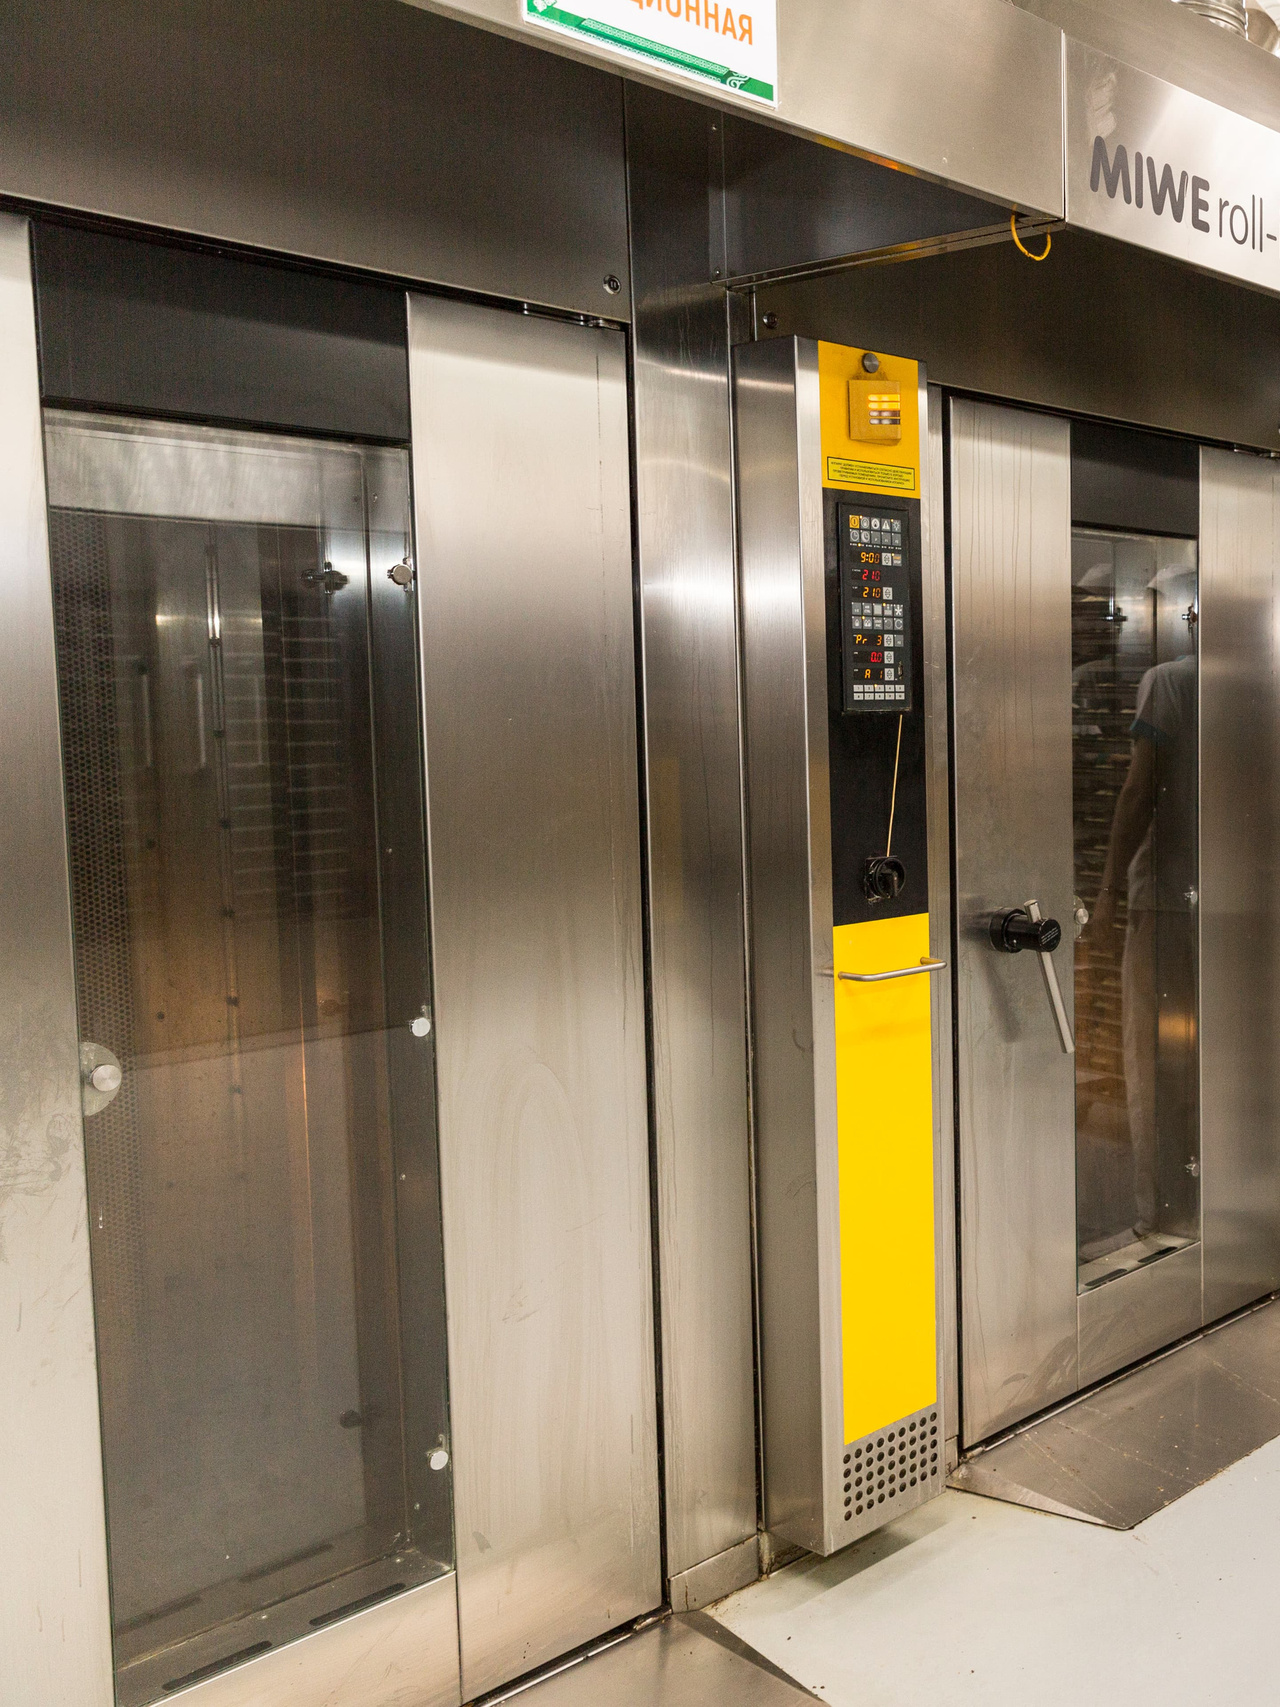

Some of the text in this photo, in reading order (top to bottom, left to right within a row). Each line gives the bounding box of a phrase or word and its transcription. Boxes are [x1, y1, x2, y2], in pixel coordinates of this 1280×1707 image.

[1090, 135, 1210, 233] MIWE
[862, 569, 881, 581] 210
[862, 586, 881, 599] 210
